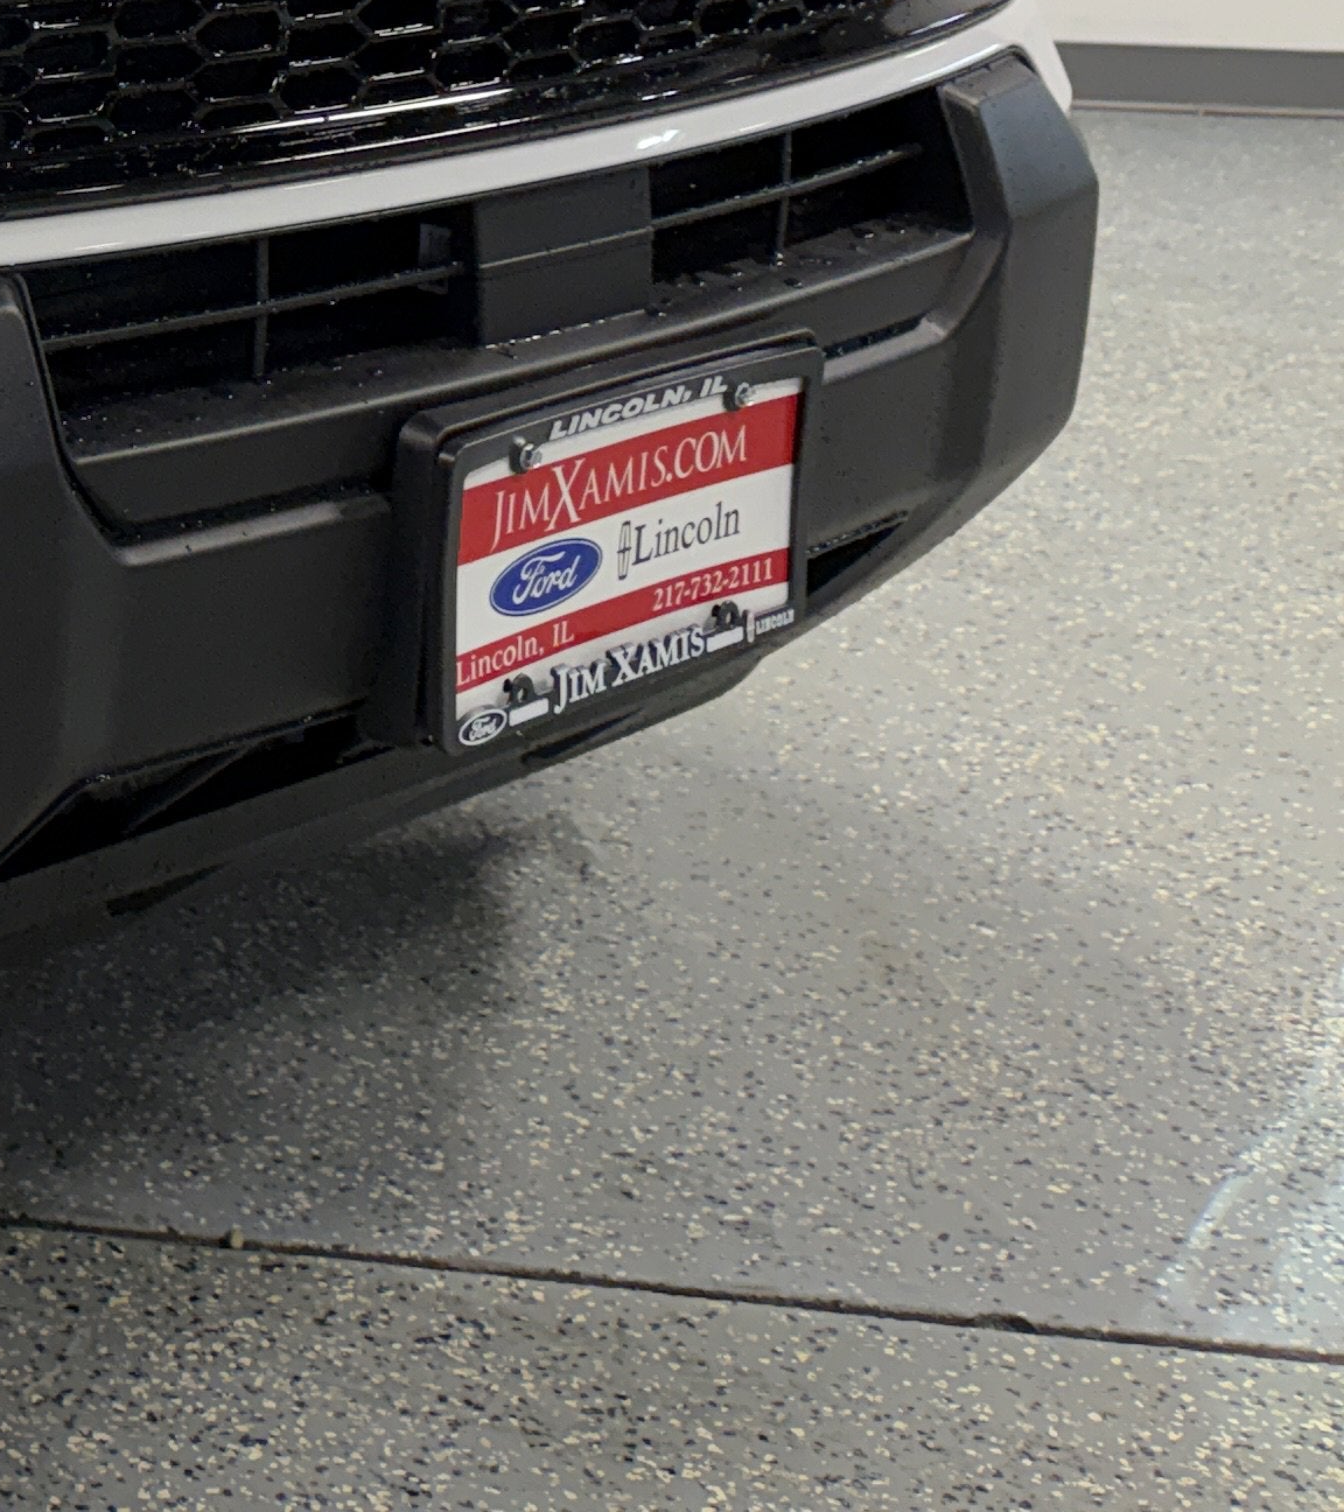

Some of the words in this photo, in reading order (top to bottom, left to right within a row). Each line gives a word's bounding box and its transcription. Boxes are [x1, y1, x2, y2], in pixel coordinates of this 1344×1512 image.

[549, 386, 690, 440] LINCOLN,
[490, 425, 747, 552] JIMXAMIS.COM
[631, 501, 740, 566] Lincoln
[511, 551, 580, 605] Ford
[652, 557, 773, 611] 217-732-2111
[457, 635, 545, 686] Lincoln,
[553, 620, 575, 645] IL
[555, 665, 607, 714] JIM
[612, 629, 705, 686] XAMIS
